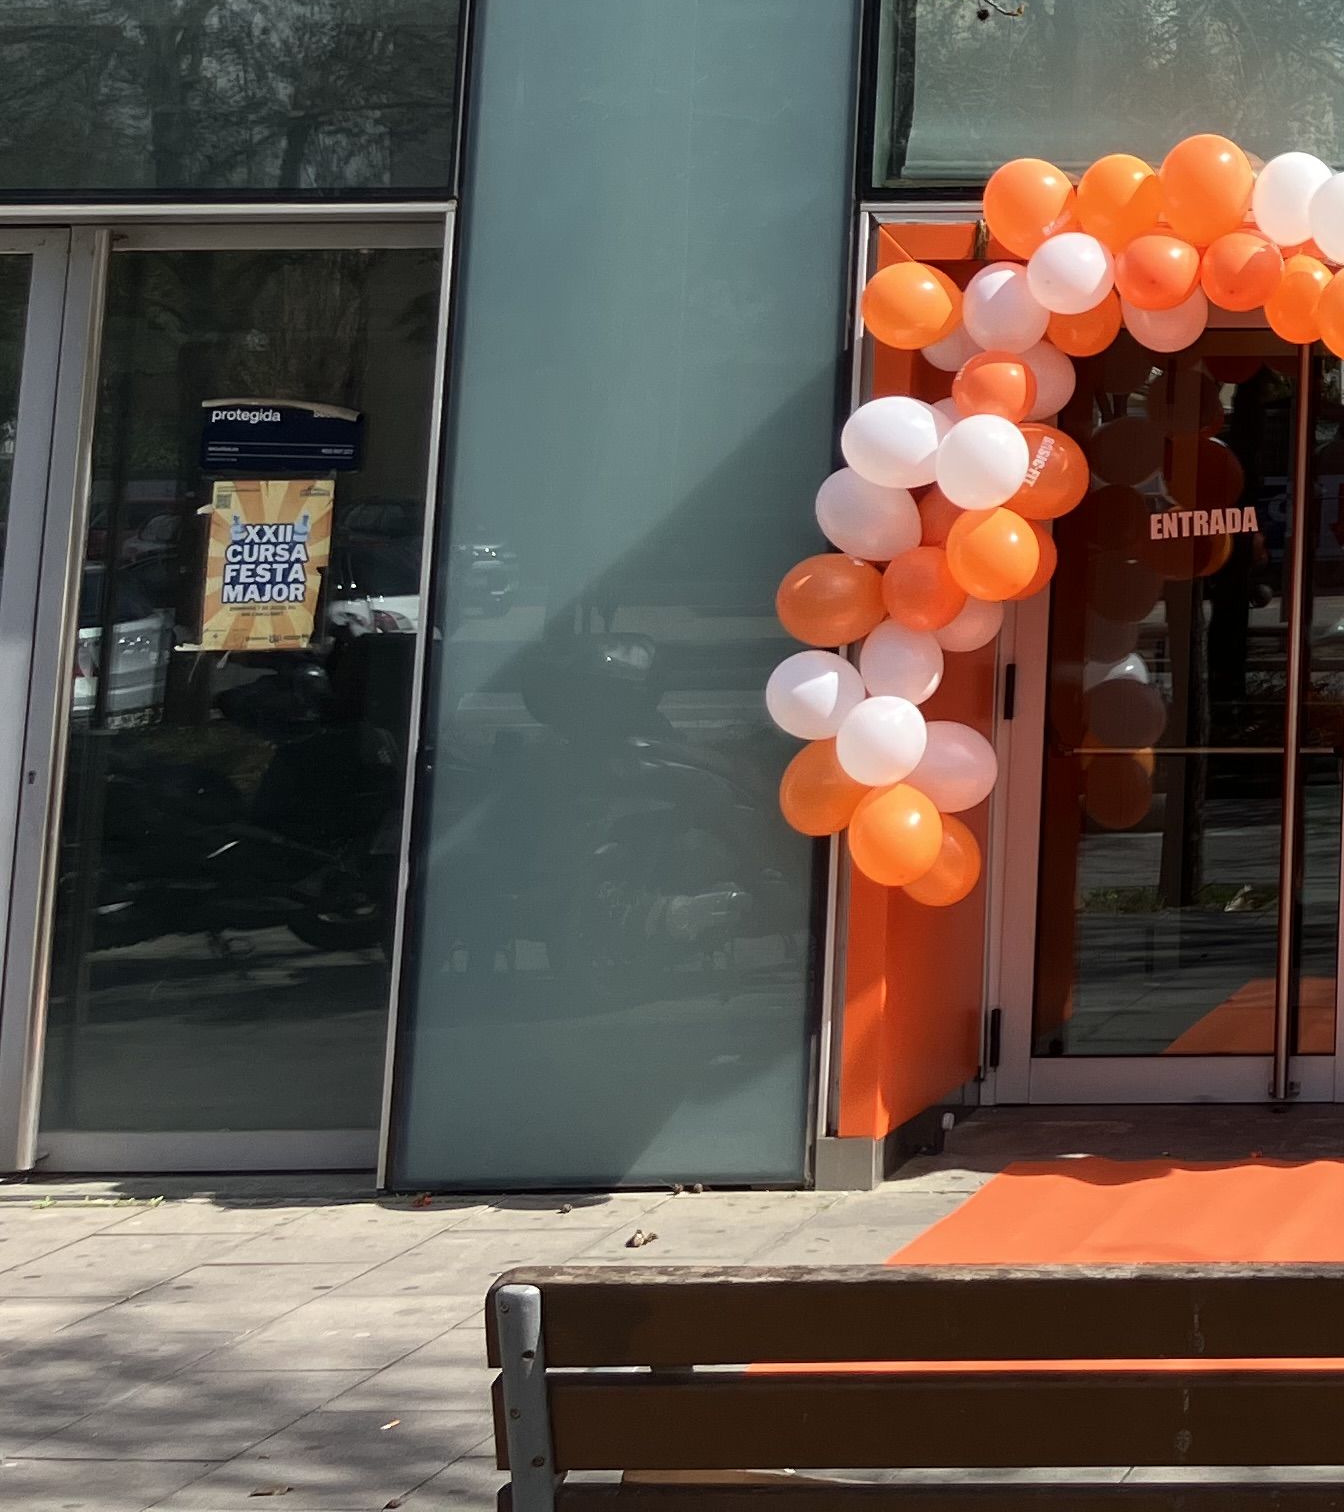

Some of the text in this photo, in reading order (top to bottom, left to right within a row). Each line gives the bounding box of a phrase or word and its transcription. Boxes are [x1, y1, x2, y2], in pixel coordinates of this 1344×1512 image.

[211, 408, 281, 425] protegida
[1149, 505, 1260, 541] ENTRADA
[244, 524, 295, 544] XXII
[225, 543, 309, 563] CURSA
[223, 563, 307, 584] FESTA
[221, 583, 306, 604] MAJOR
